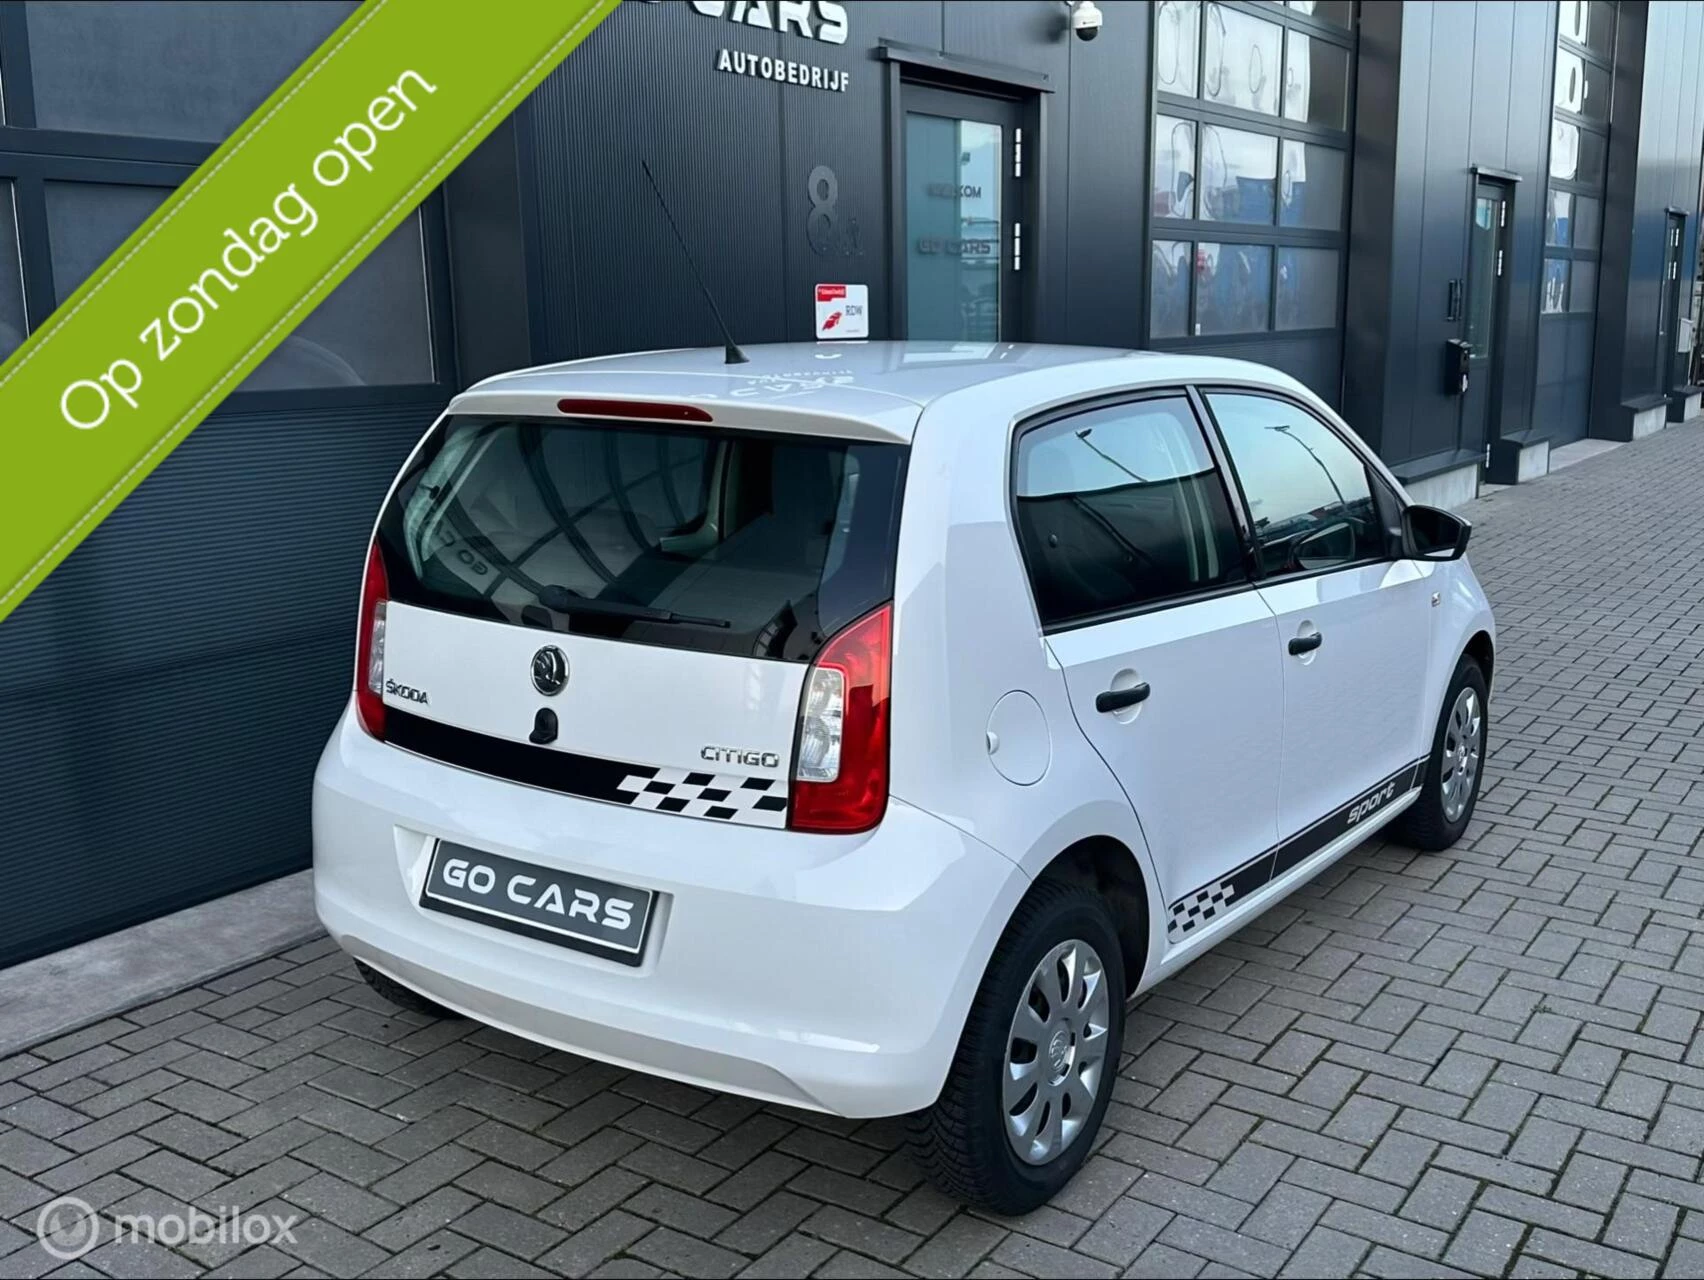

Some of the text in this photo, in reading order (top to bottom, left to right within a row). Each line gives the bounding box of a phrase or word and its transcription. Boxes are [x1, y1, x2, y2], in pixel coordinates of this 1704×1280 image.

[718, 48, 849, 92] AUTOBEDRIJF
[1347, 781, 1395, 824] sport
[443, 858, 634, 930] GO CARS
